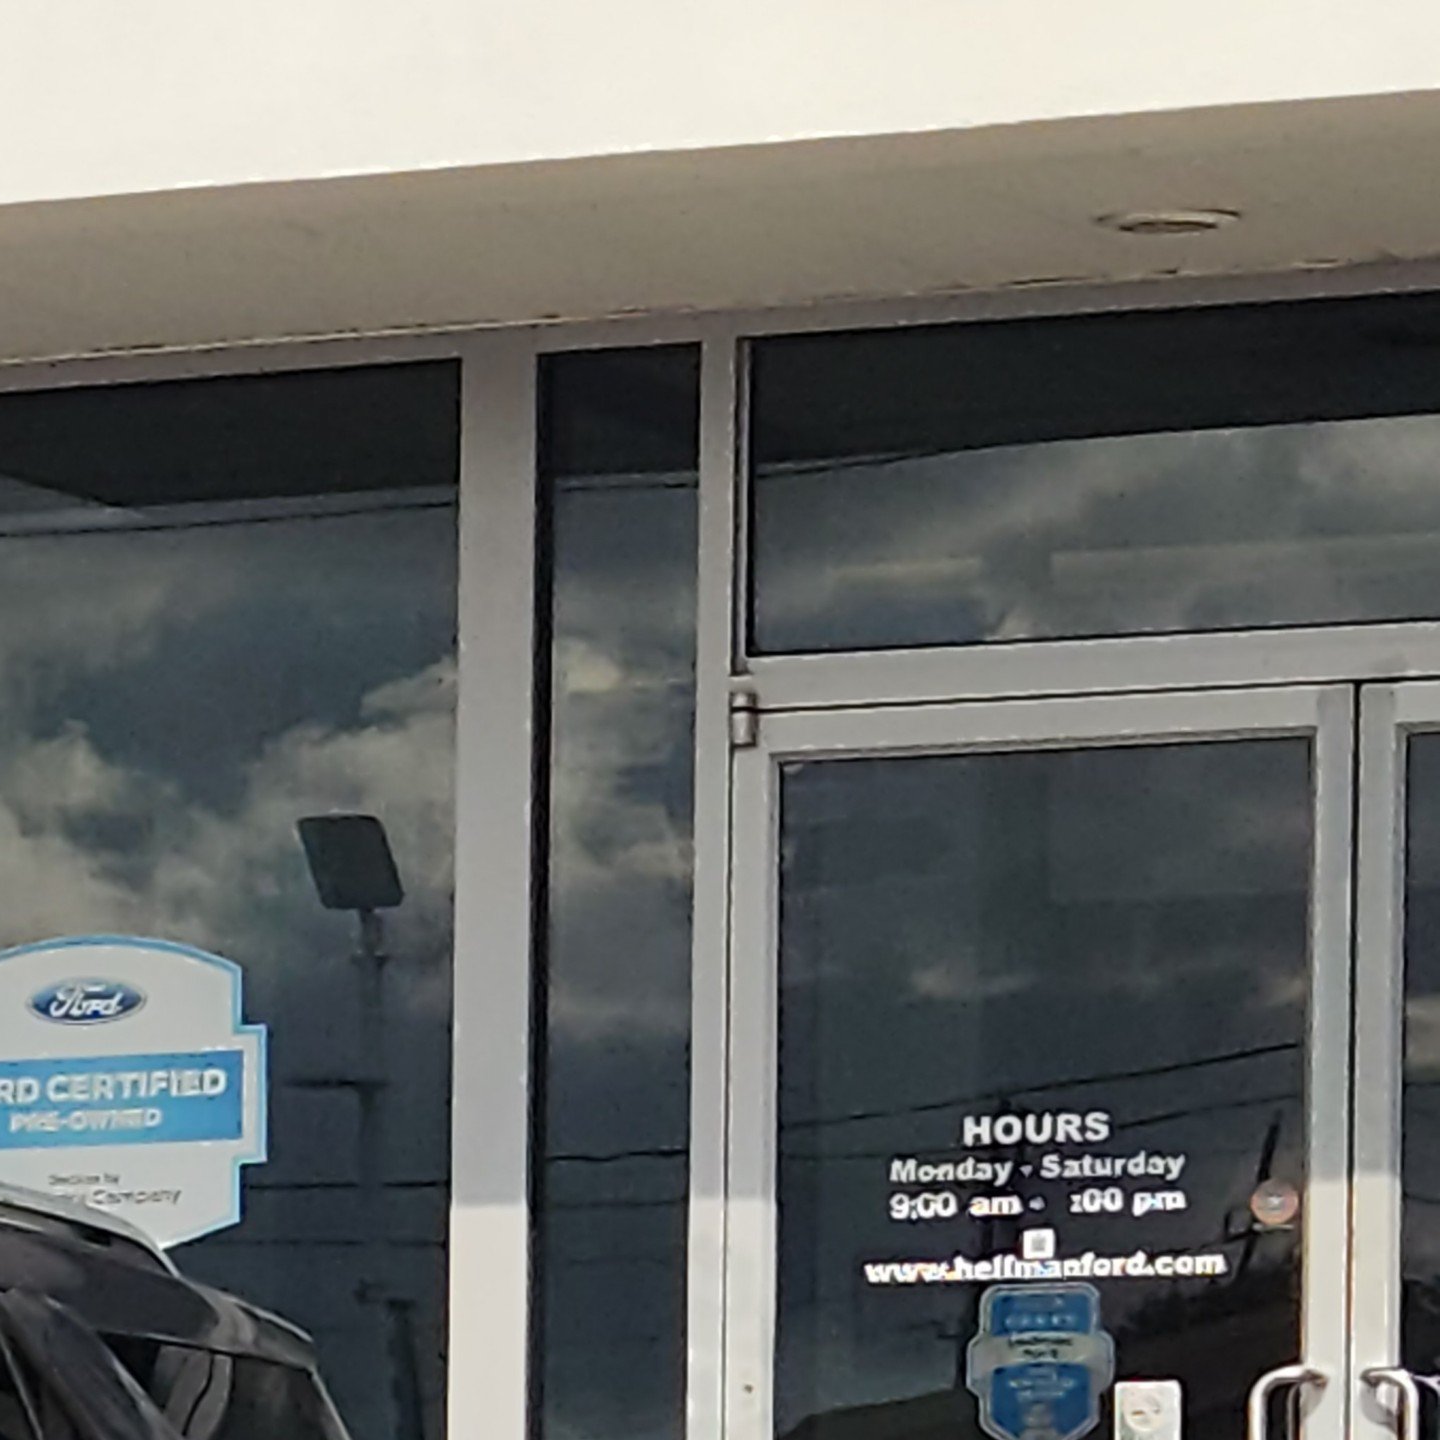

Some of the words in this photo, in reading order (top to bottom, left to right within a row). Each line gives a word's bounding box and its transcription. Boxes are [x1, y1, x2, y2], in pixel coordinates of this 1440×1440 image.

[49, 983, 122, 1018] Ford
[46, 1068, 228, 1102] CERTIFIED
[9, 1107, 163, 1133] PRE-OWNED
[962, 1111, 1110, 1147] HOURS
[889, 1156, 1013, 1187] Monday
[1040, 1150, 1186, 1181] Saturday
[889, 1190, 958, 1220] 9:00
[968, 1195, 1024, 1217] am
[1132, 1190, 1188, 1217] pm
[864, 1251, 1229, 1284] www.helfmanford.com
